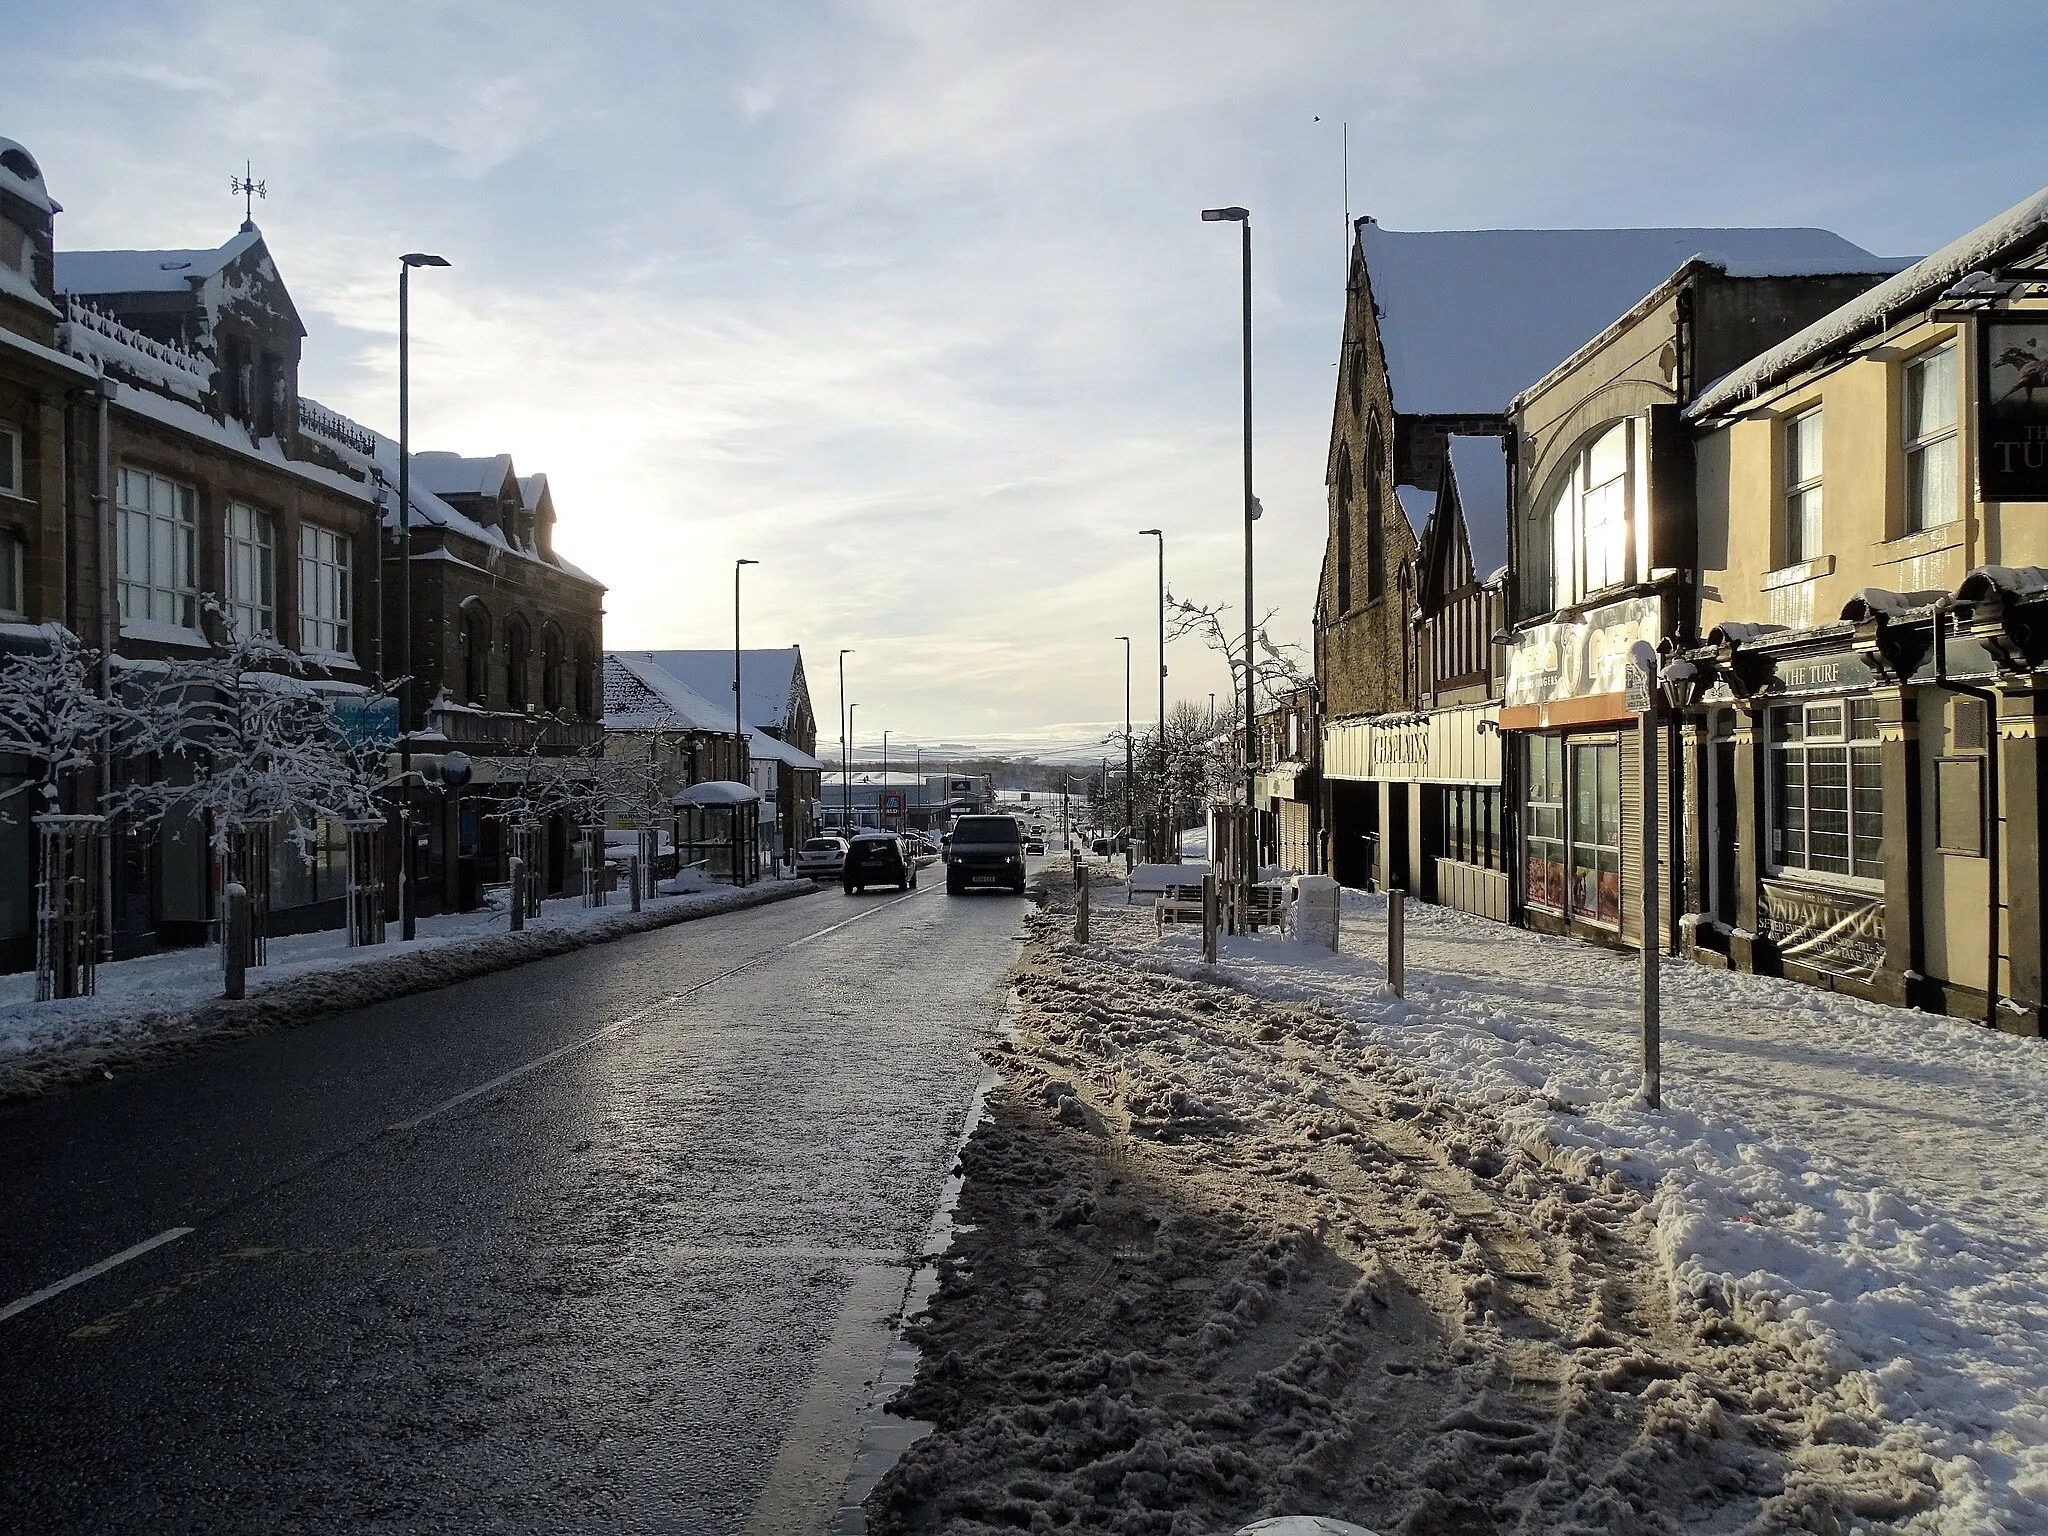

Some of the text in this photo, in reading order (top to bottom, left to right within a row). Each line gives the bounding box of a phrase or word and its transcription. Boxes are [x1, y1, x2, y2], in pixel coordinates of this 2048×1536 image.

[1784, 663, 1839, 686] THE TURF
[1374, 733, 1429, 764] CHAPLAINS
[1758, 895, 1819, 927] SUNDAY
[1758, 918, 1784, 933] SEED
[1841, 947, 1863, 962] TAKE
